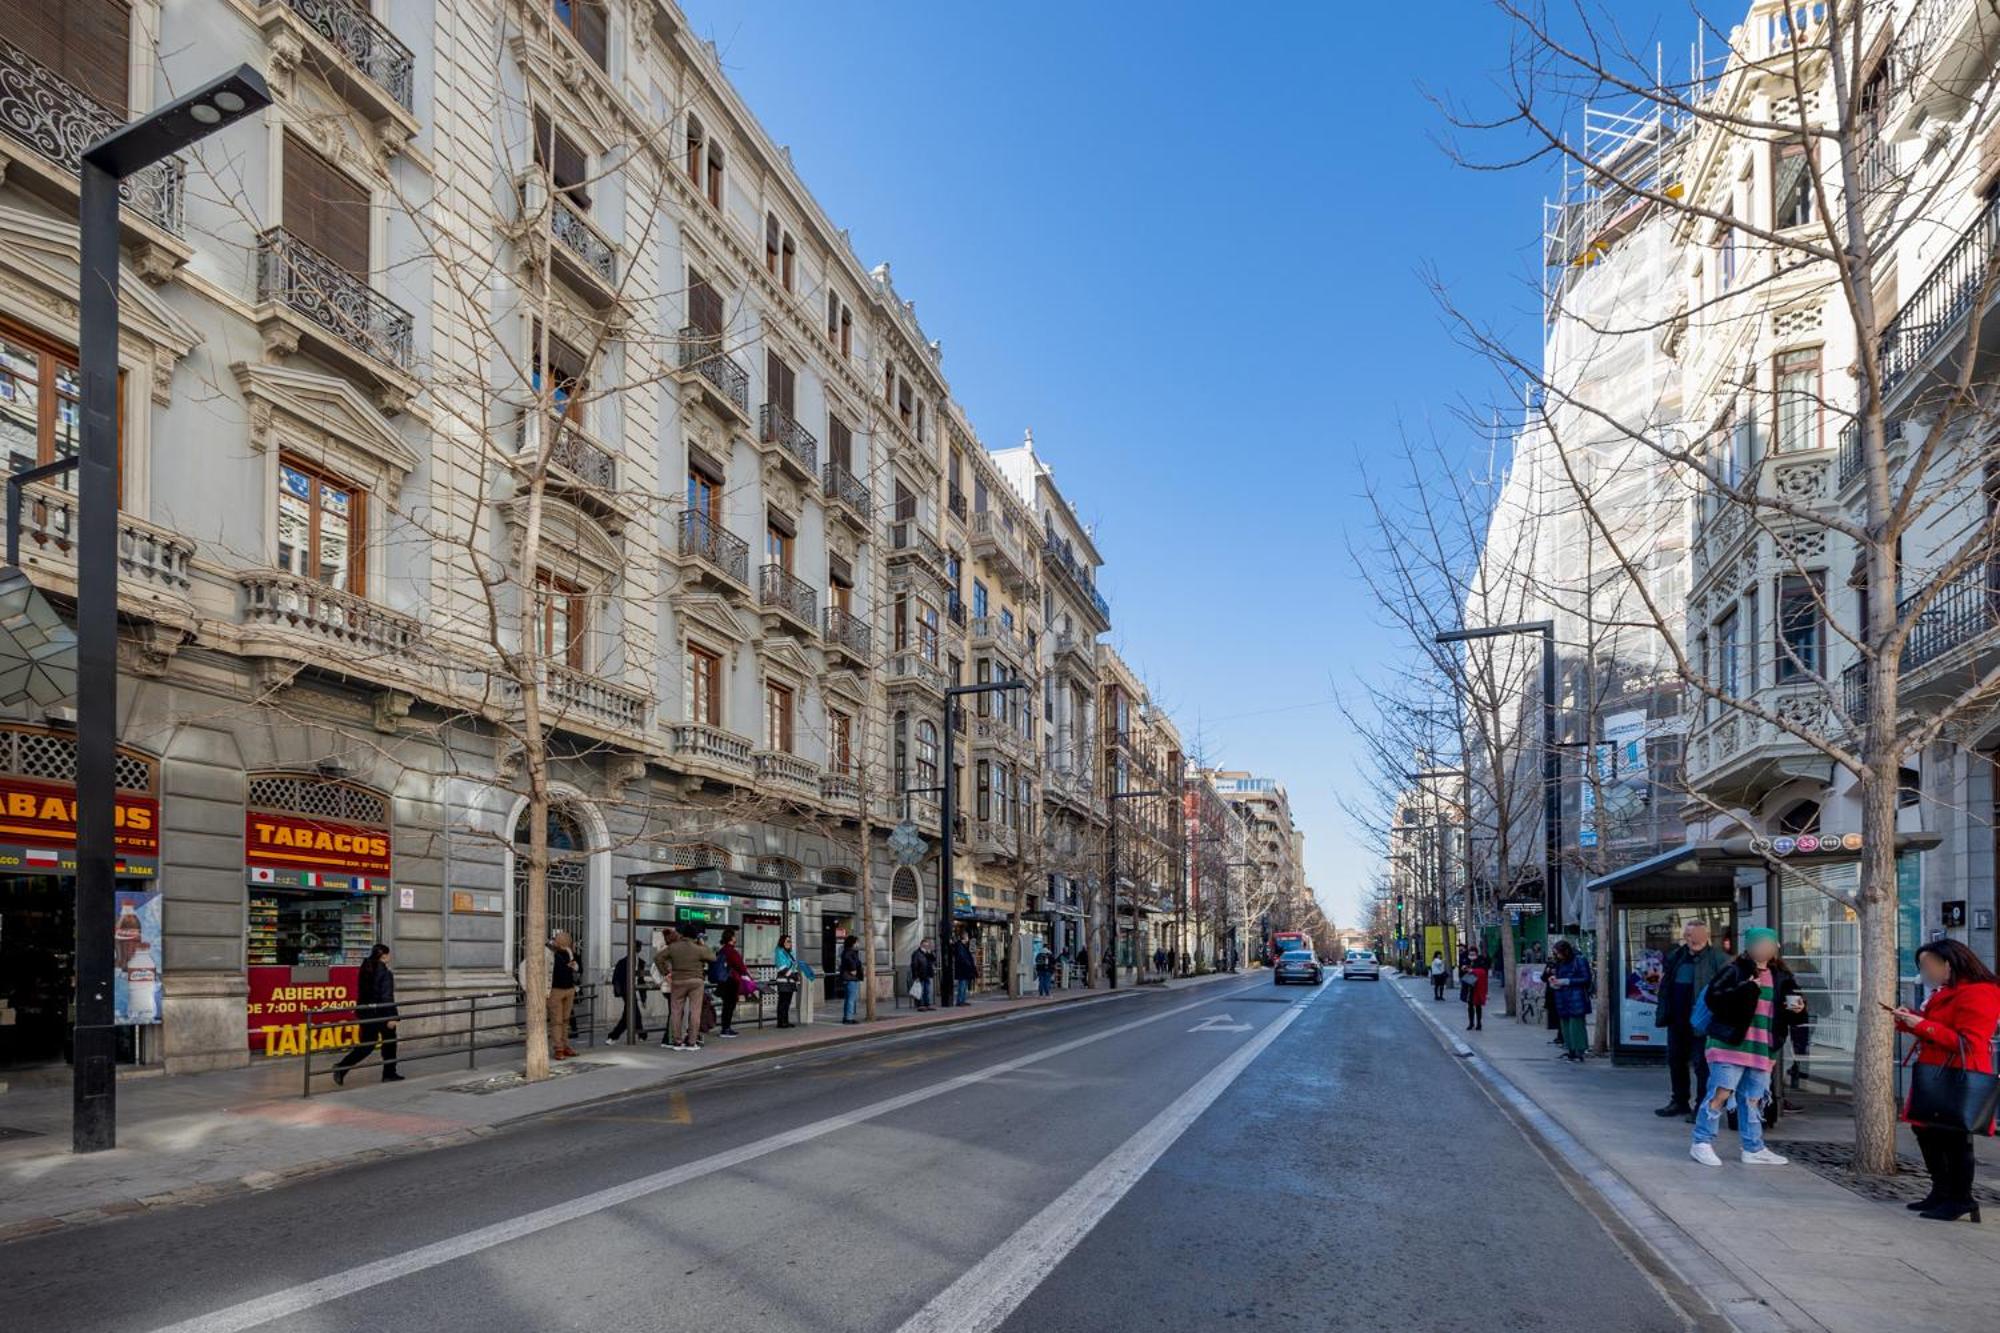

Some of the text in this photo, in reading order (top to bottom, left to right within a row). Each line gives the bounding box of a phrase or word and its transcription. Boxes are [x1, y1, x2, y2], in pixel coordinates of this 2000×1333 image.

[255, 823, 387, 857] TABACOS
[271, 986, 347, 1001] ABIERTO
[266, 1002, 297, 1013] 7:00
